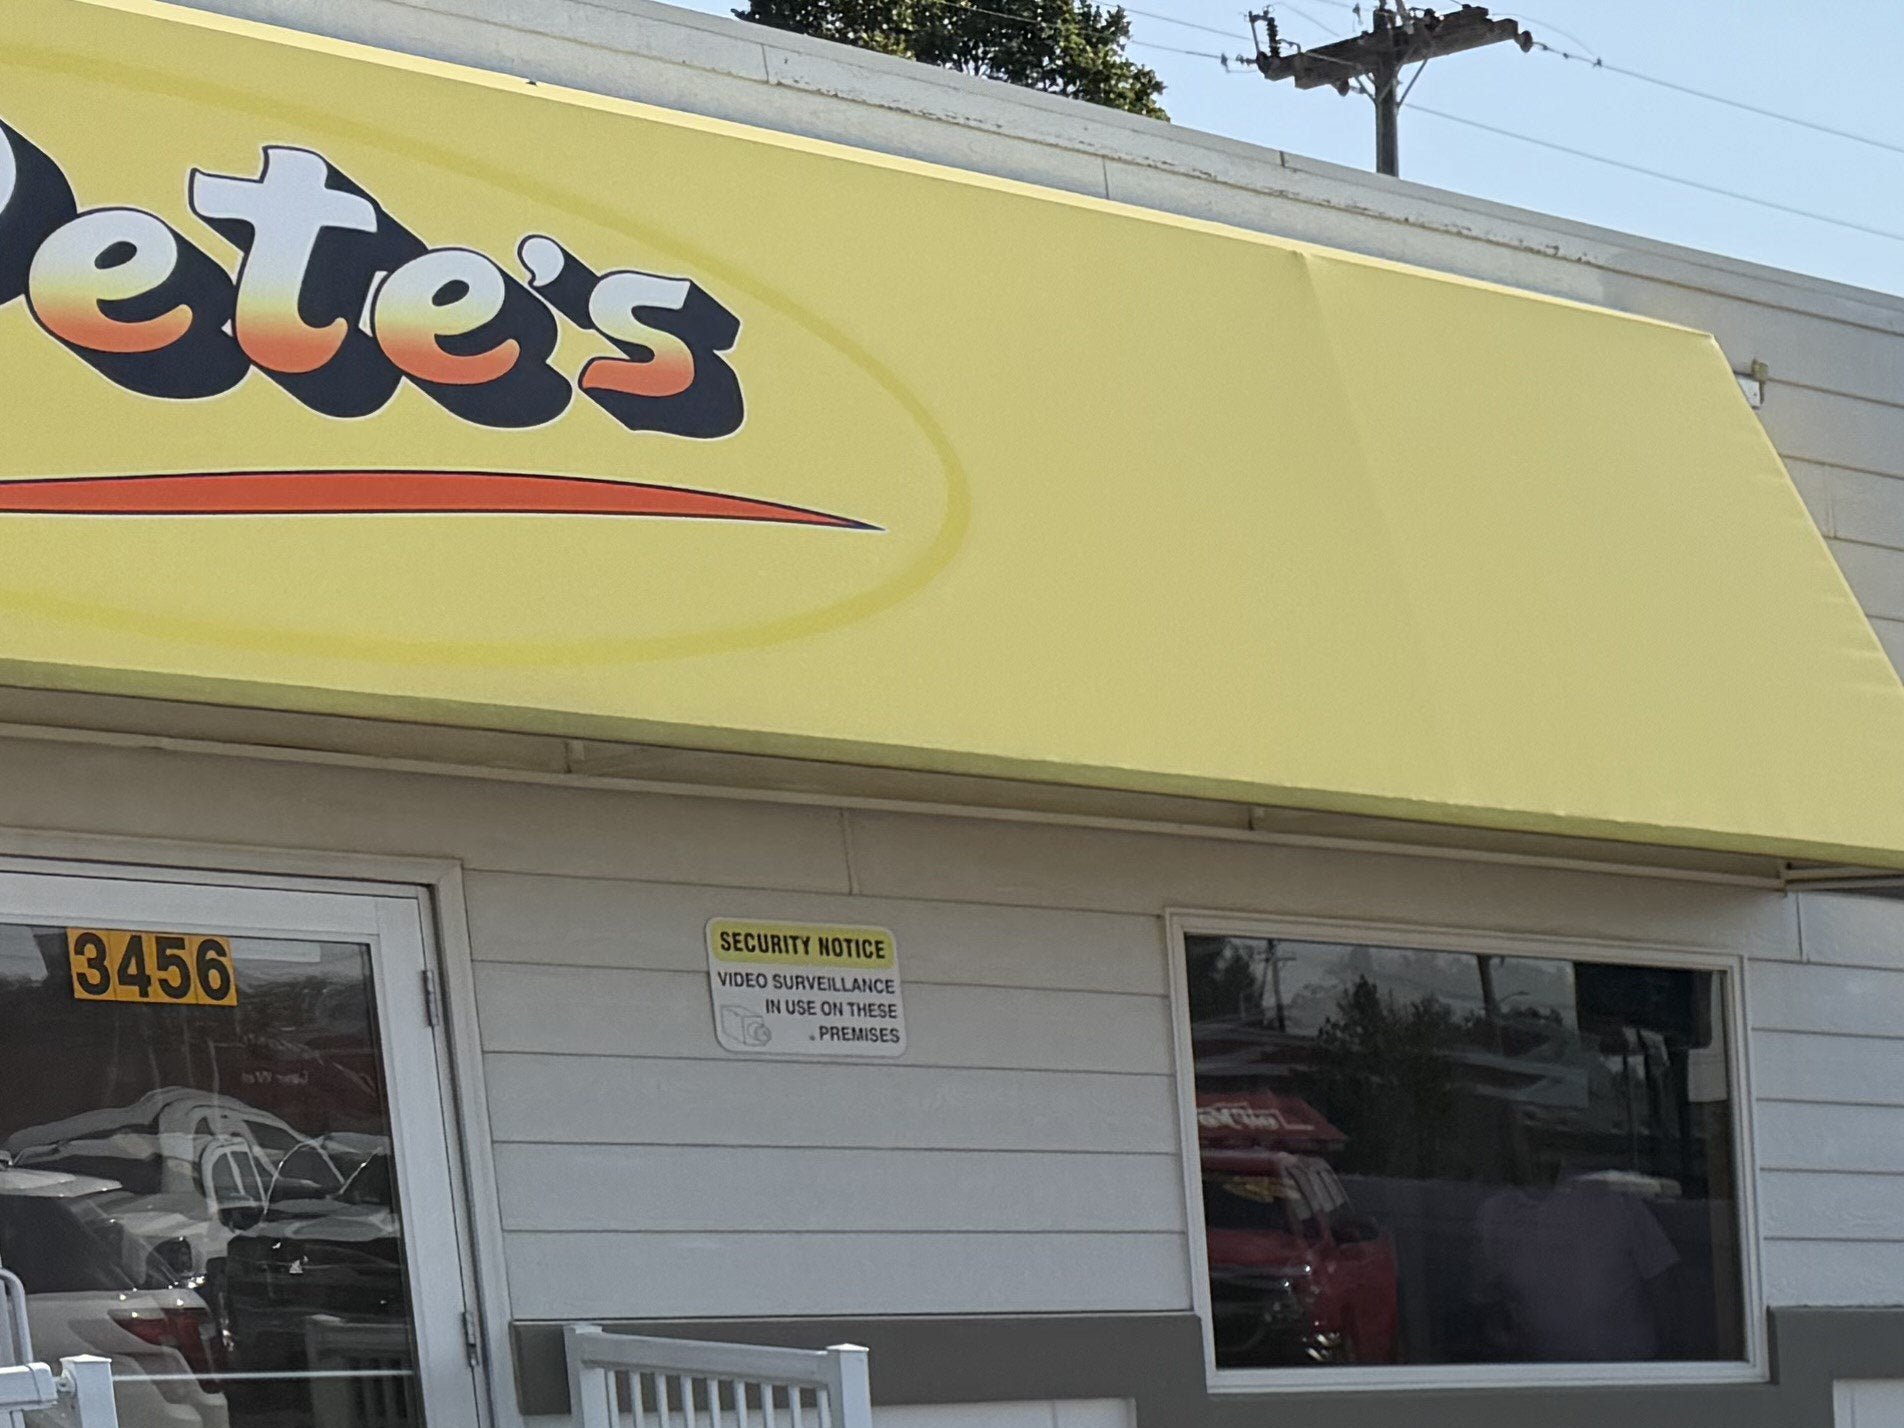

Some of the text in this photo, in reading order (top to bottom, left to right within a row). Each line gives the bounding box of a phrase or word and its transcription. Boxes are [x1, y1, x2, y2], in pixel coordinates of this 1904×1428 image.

[0, 123, 712, 408] ete's
[720, 931, 886, 959] SECURITY NOTICE
[74, 932, 231, 1001] 3456
[717, 971, 896, 994] VIDEO SURVEILLANCE
[766, 998, 898, 1019] IN USE ON THESE
[819, 1026, 901, 1043] PREMISES
